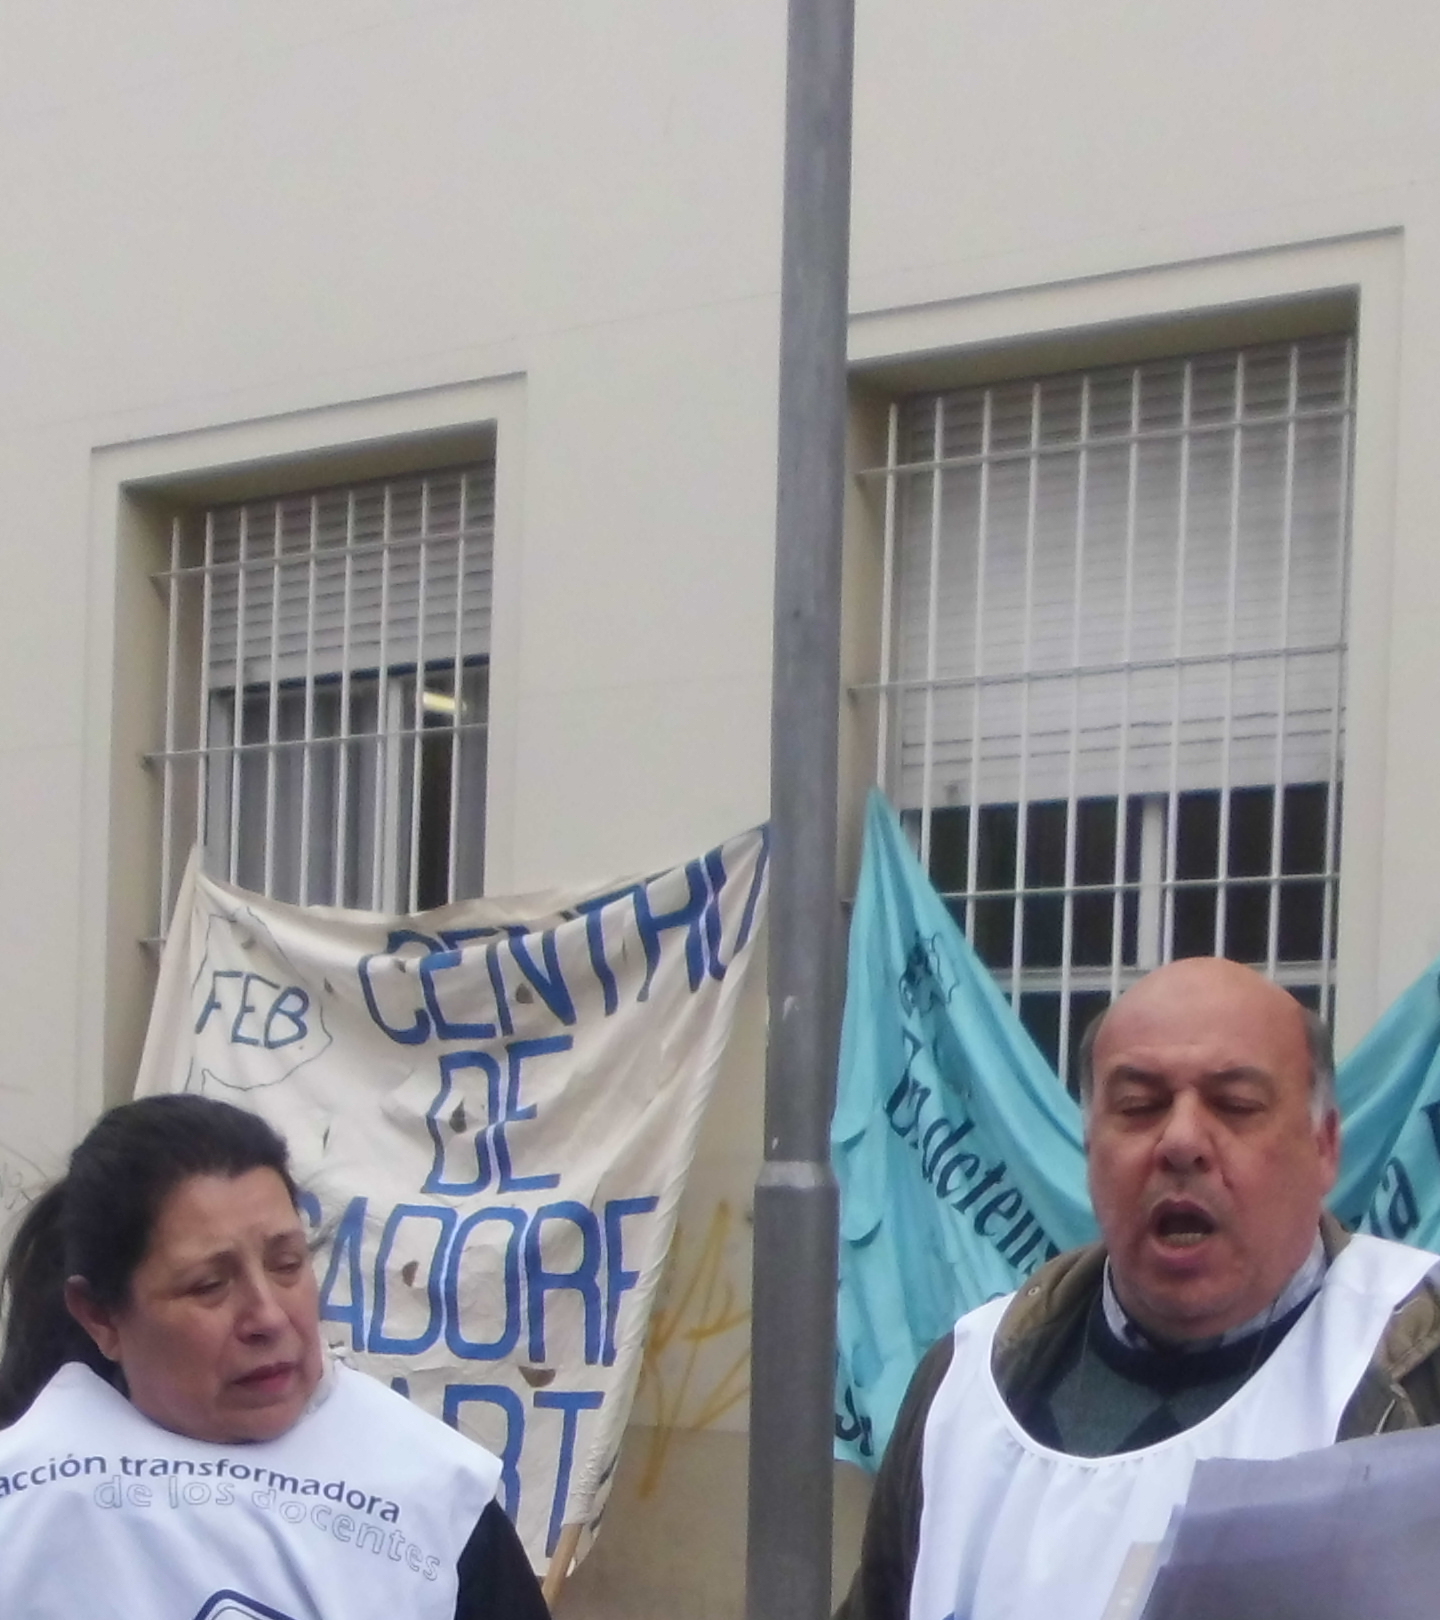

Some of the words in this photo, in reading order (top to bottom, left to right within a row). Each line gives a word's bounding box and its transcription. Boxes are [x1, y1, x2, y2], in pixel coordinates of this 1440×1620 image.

[195, 970, 310, 1050] FEB
[421, 1035, 573, 1196] DE
[93, 1474, 153, 1509] de
[168, 1475, 235, 1508] los
[251, 1487, 442, 1582] docentes
[119, 1454, 401, 1524] transformadora
